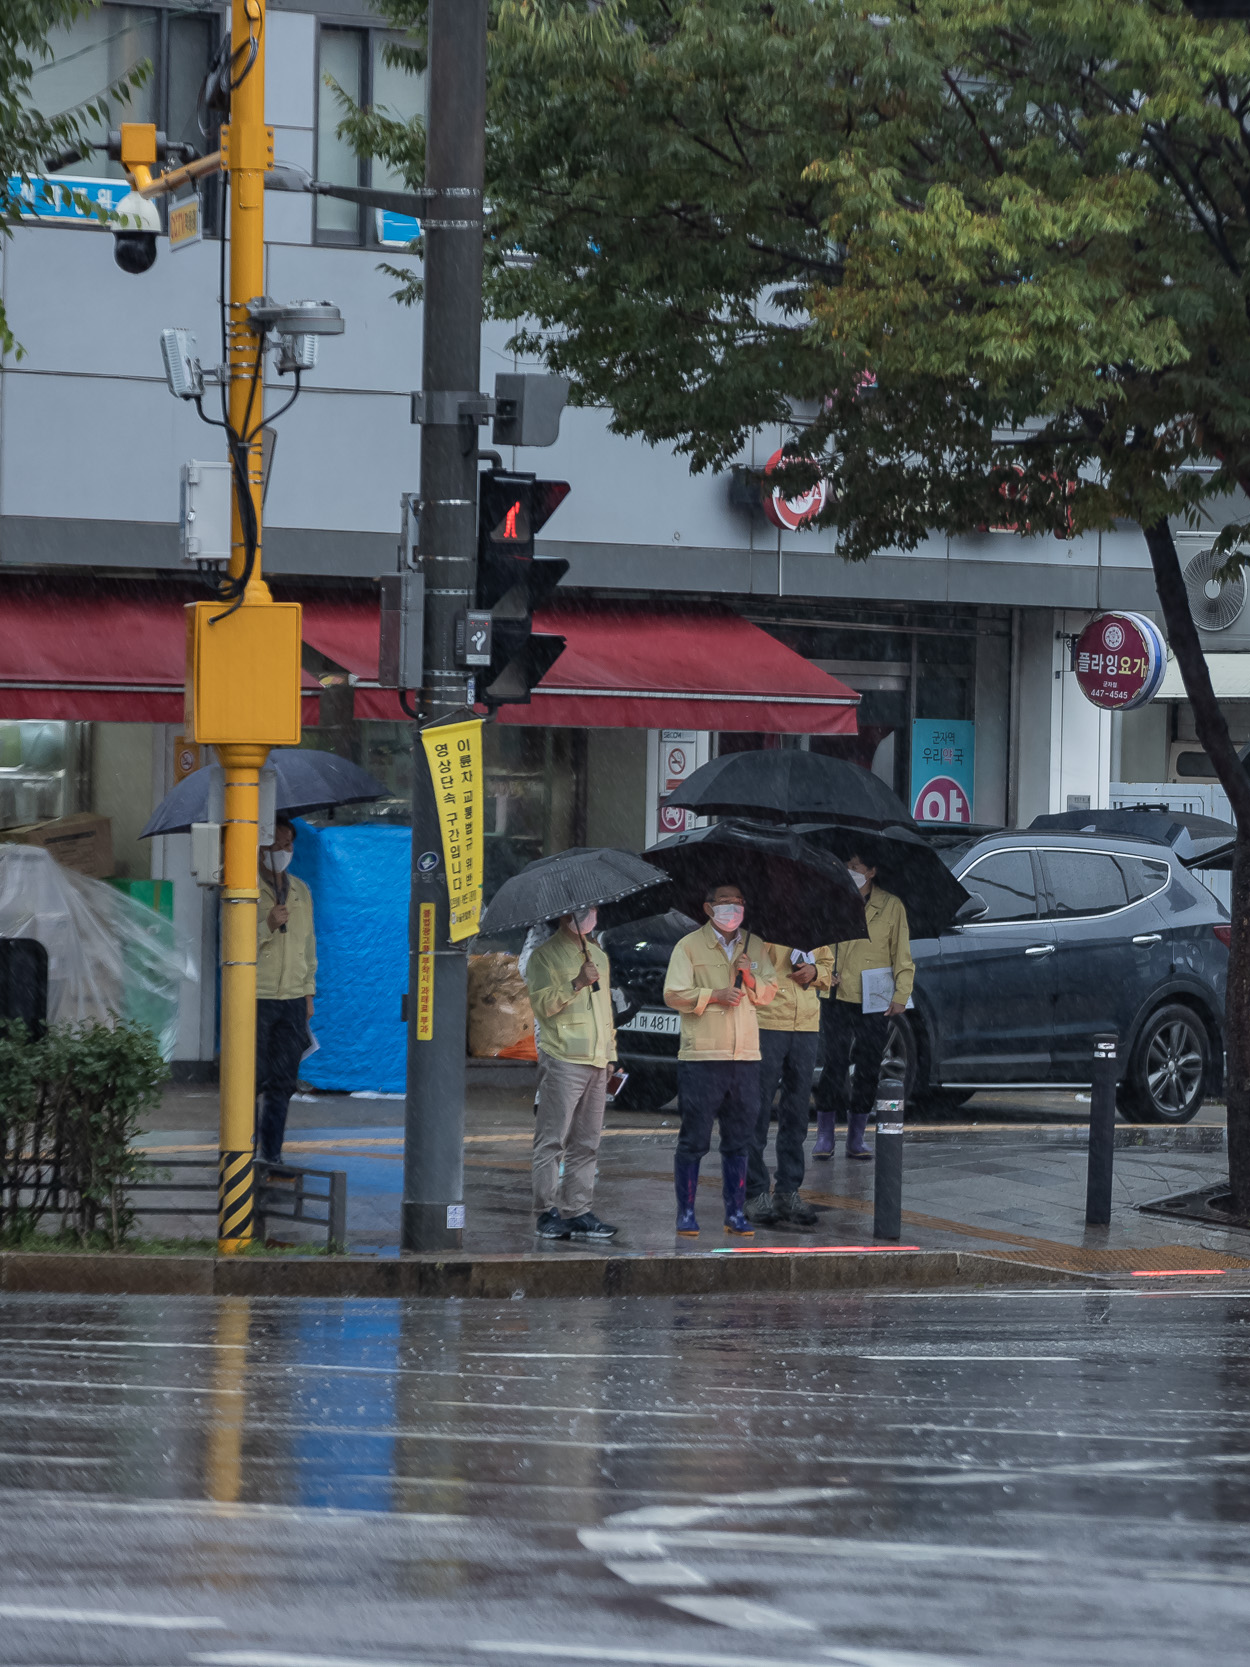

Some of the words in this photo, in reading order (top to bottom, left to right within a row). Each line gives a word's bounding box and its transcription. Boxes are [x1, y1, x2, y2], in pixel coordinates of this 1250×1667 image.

[1078, 652, 1149, 679] 플라잉요가
[1091, 689, 1128, 699] 447-4545
[932, 731, 955, 744] 군자역
[457, 738, 473, 783] 이륜차
[922, 748, 964, 766] 우리약국
[434, 743, 456, 804] 영상단속
[446, 812, 463, 891] 구간입니다
[463, 790, 474, 851] 교통법규
[466, 857, 473, 887] 위반
[650, 1015, 677, 1032] 4811
